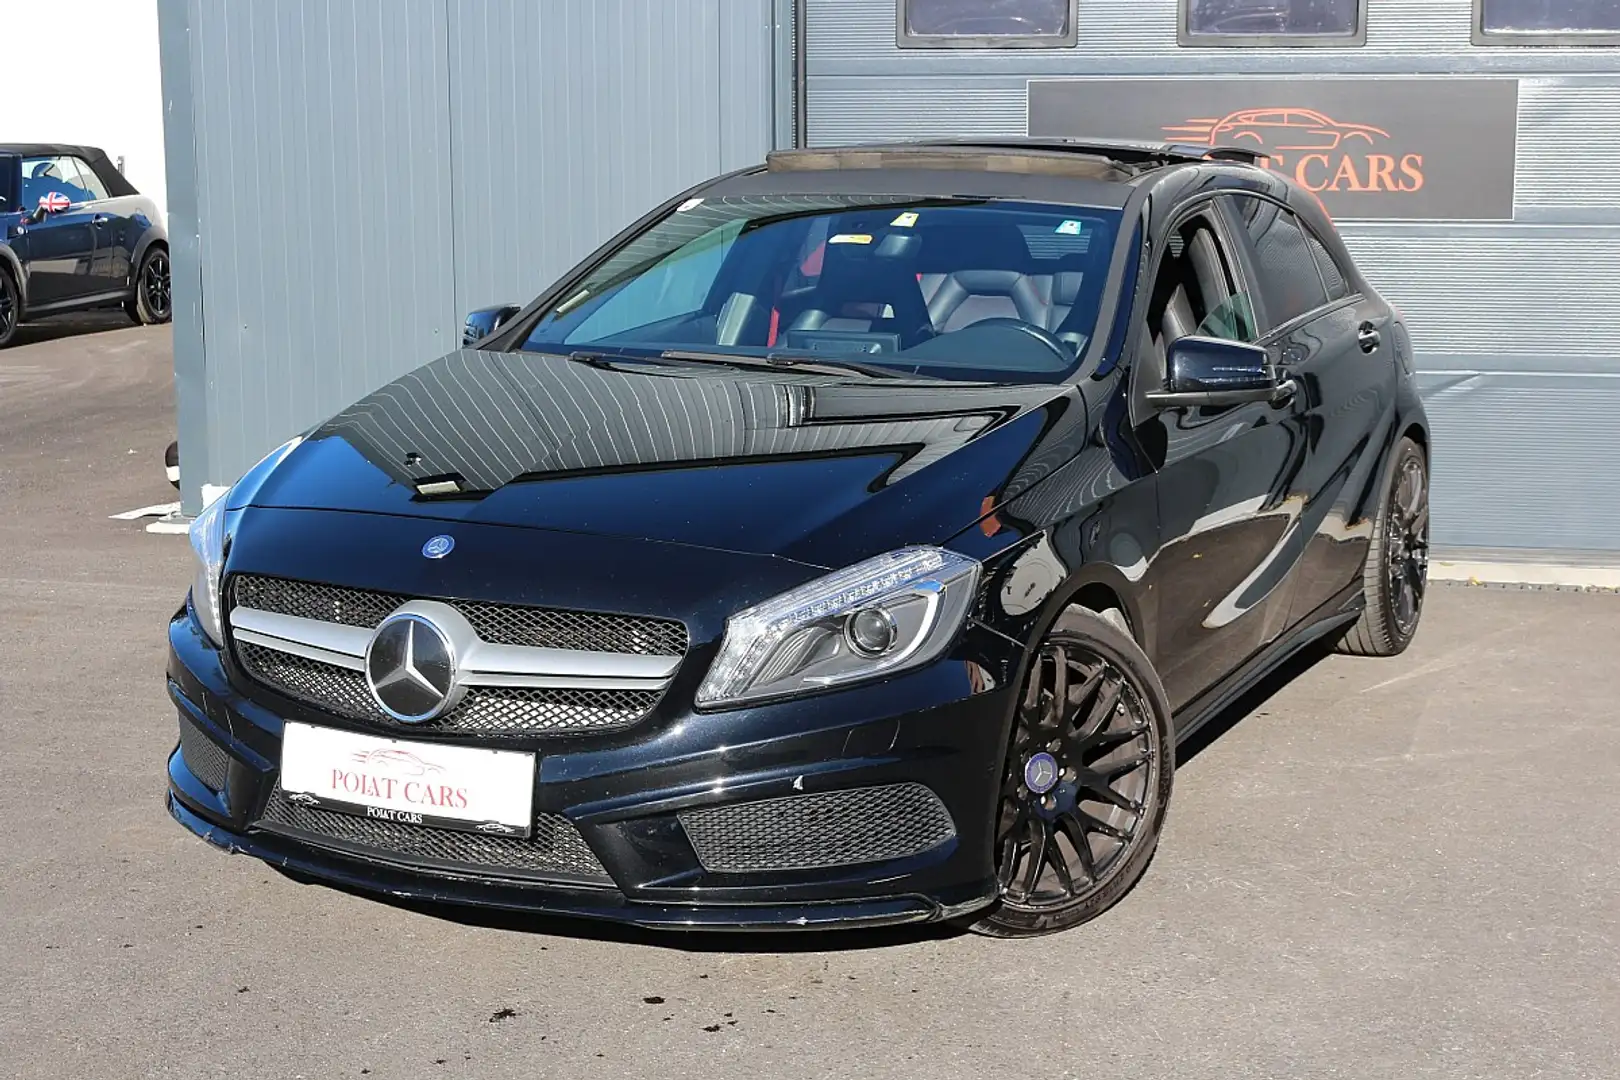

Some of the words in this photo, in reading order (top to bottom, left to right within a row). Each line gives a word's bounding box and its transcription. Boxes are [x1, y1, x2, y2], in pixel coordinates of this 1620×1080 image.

[1295, 153, 1424, 192] CARS
[403, 781, 468, 809] CARS
[397, 811, 423, 824] CARS
